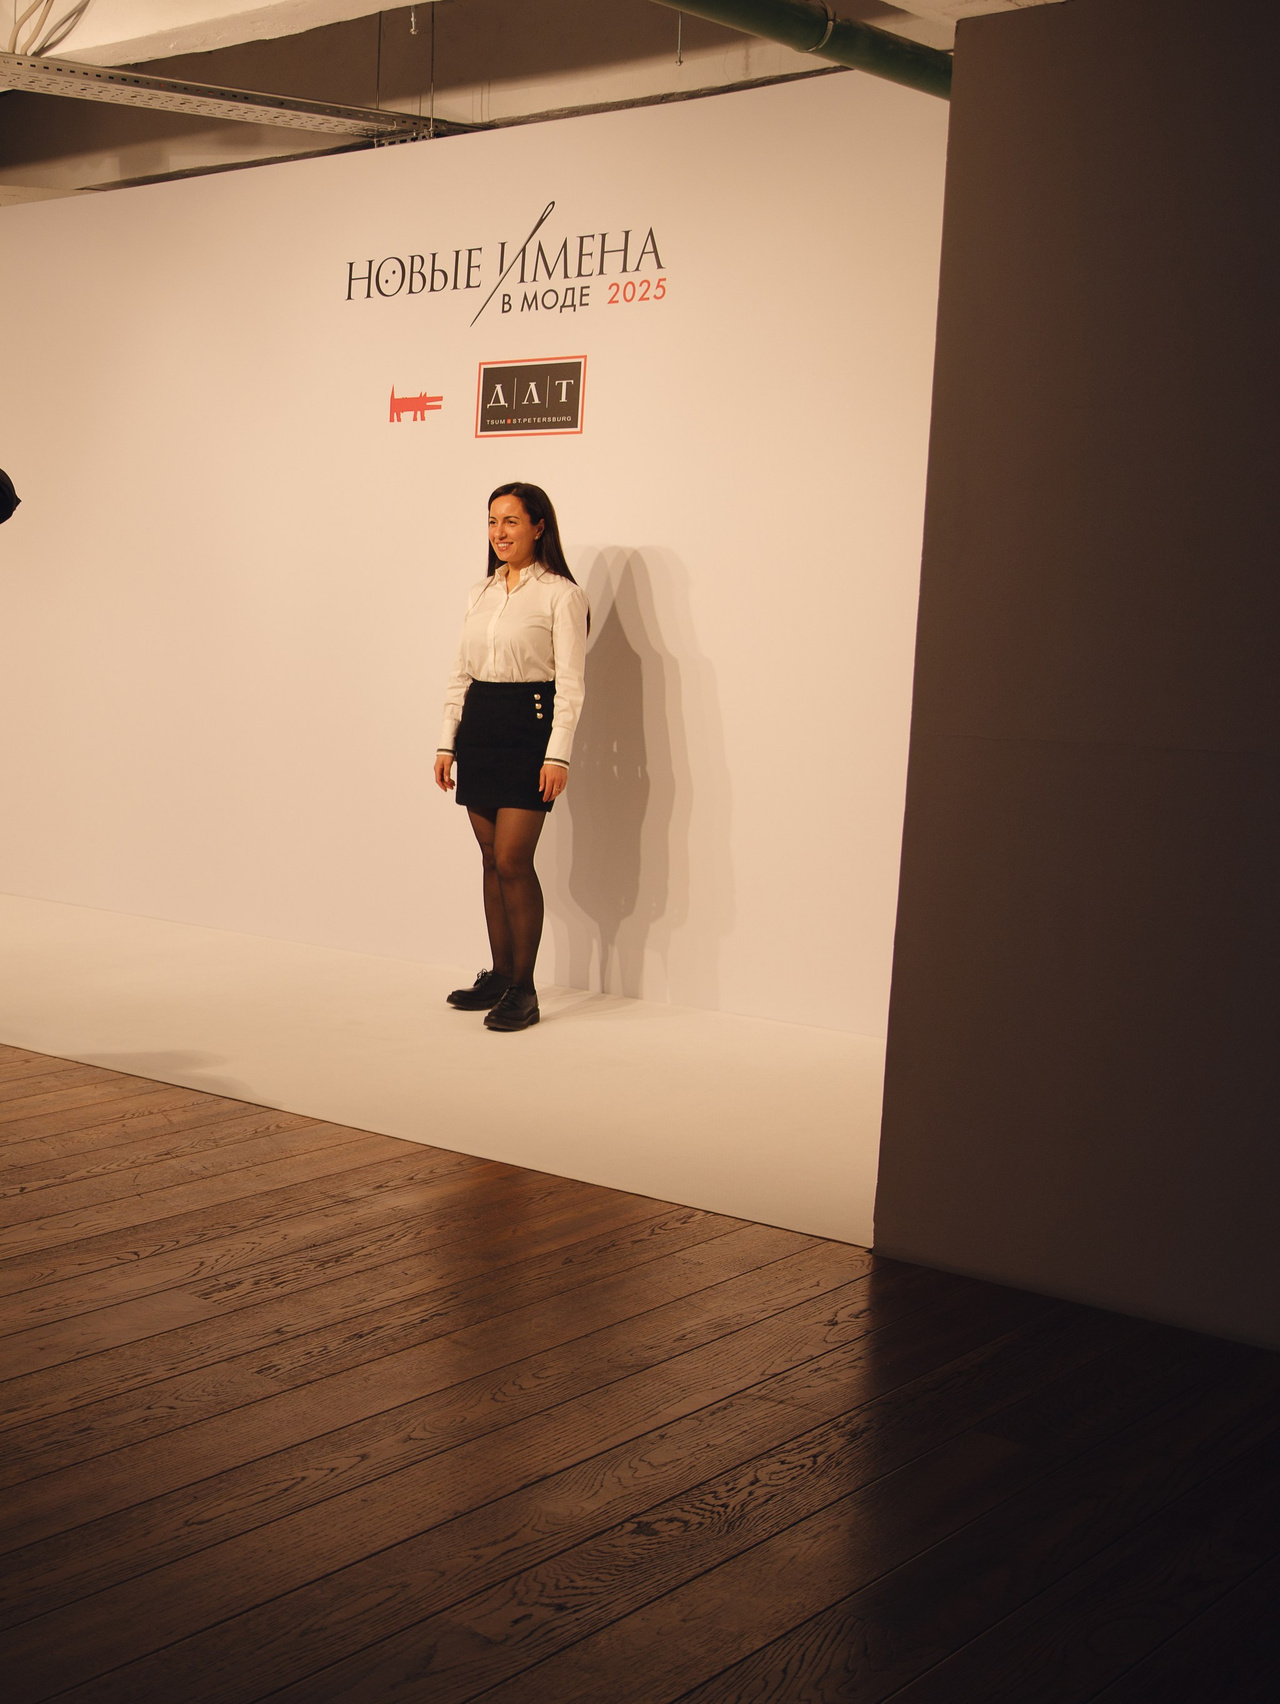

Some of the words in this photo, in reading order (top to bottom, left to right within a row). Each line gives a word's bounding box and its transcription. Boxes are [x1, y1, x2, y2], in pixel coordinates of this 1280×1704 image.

[345, 246, 483, 301] НОВЫЕ
[500, 293, 513, 314] В
[520, 285, 591, 314] МОДЕ
[607, 277, 667, 305] 2025
[512, 415, 572, 425] ST.PETERSBURG
